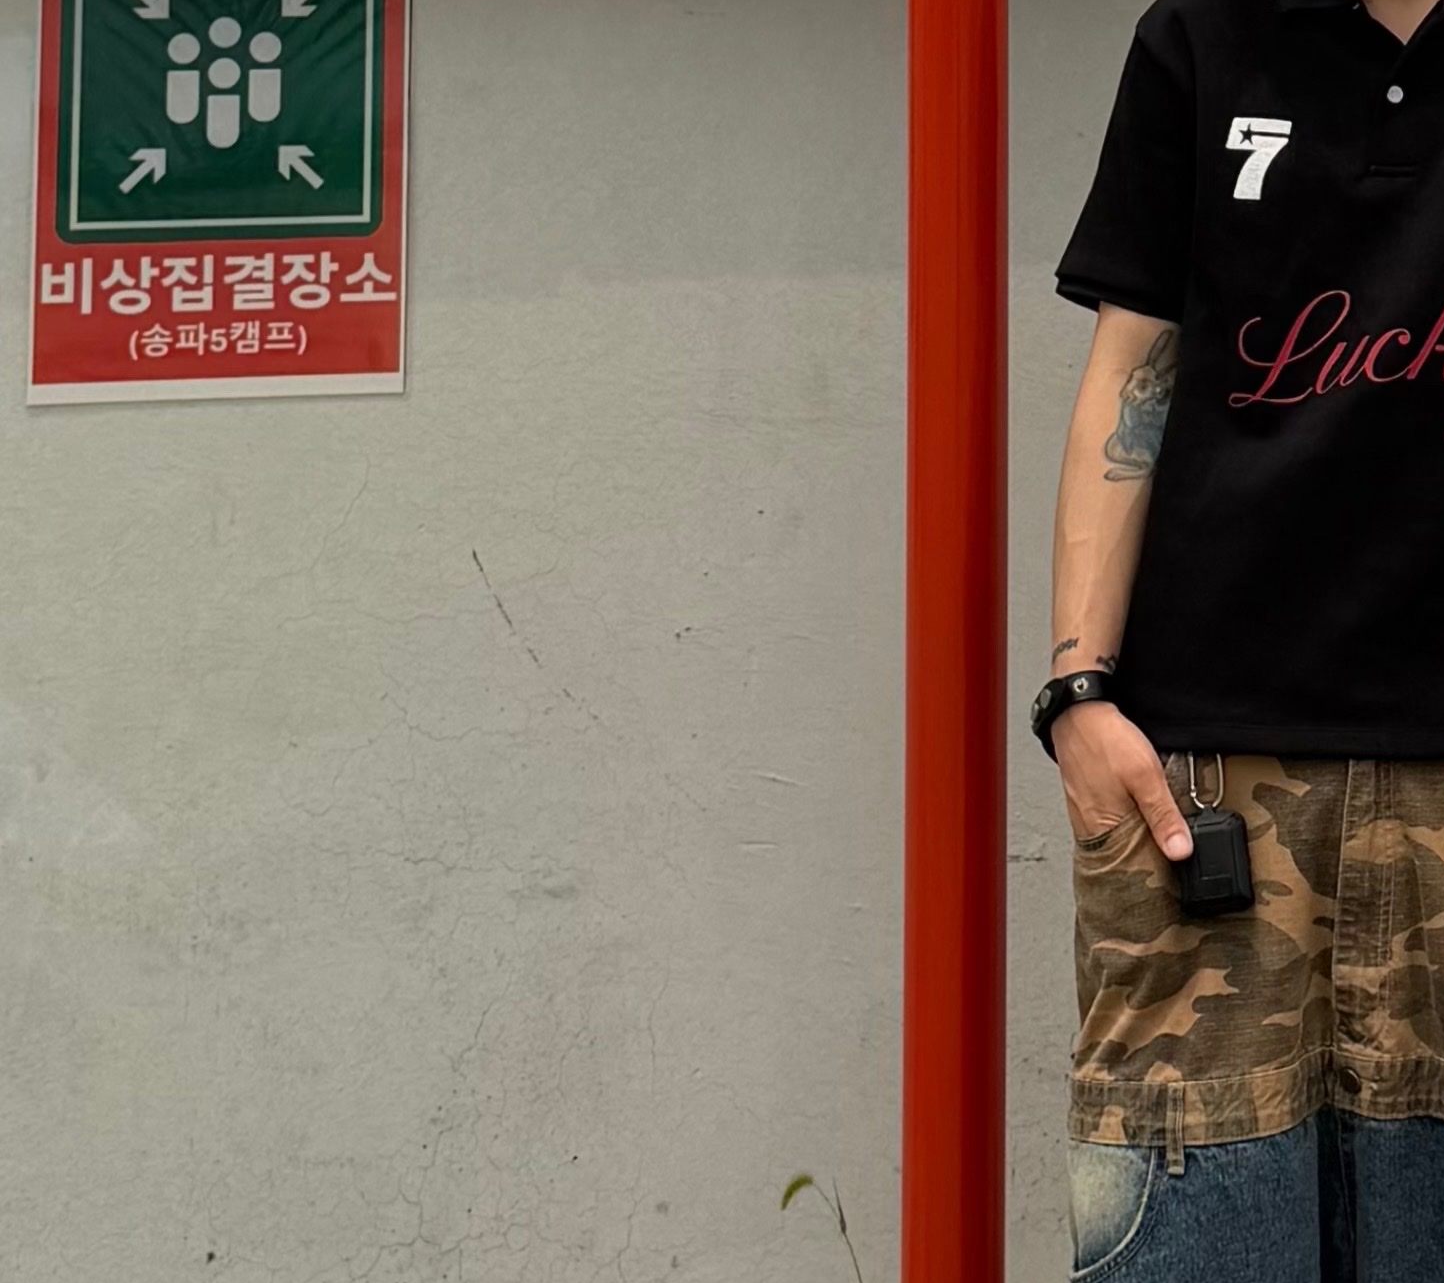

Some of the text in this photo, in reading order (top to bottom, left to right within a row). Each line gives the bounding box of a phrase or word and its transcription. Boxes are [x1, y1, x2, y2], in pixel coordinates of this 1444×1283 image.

[1225, 117, 1292, 200] 7
[40, 250, 398, 315] 비상집결장소
[128, 319, 309, 361] (송파5캠프)
